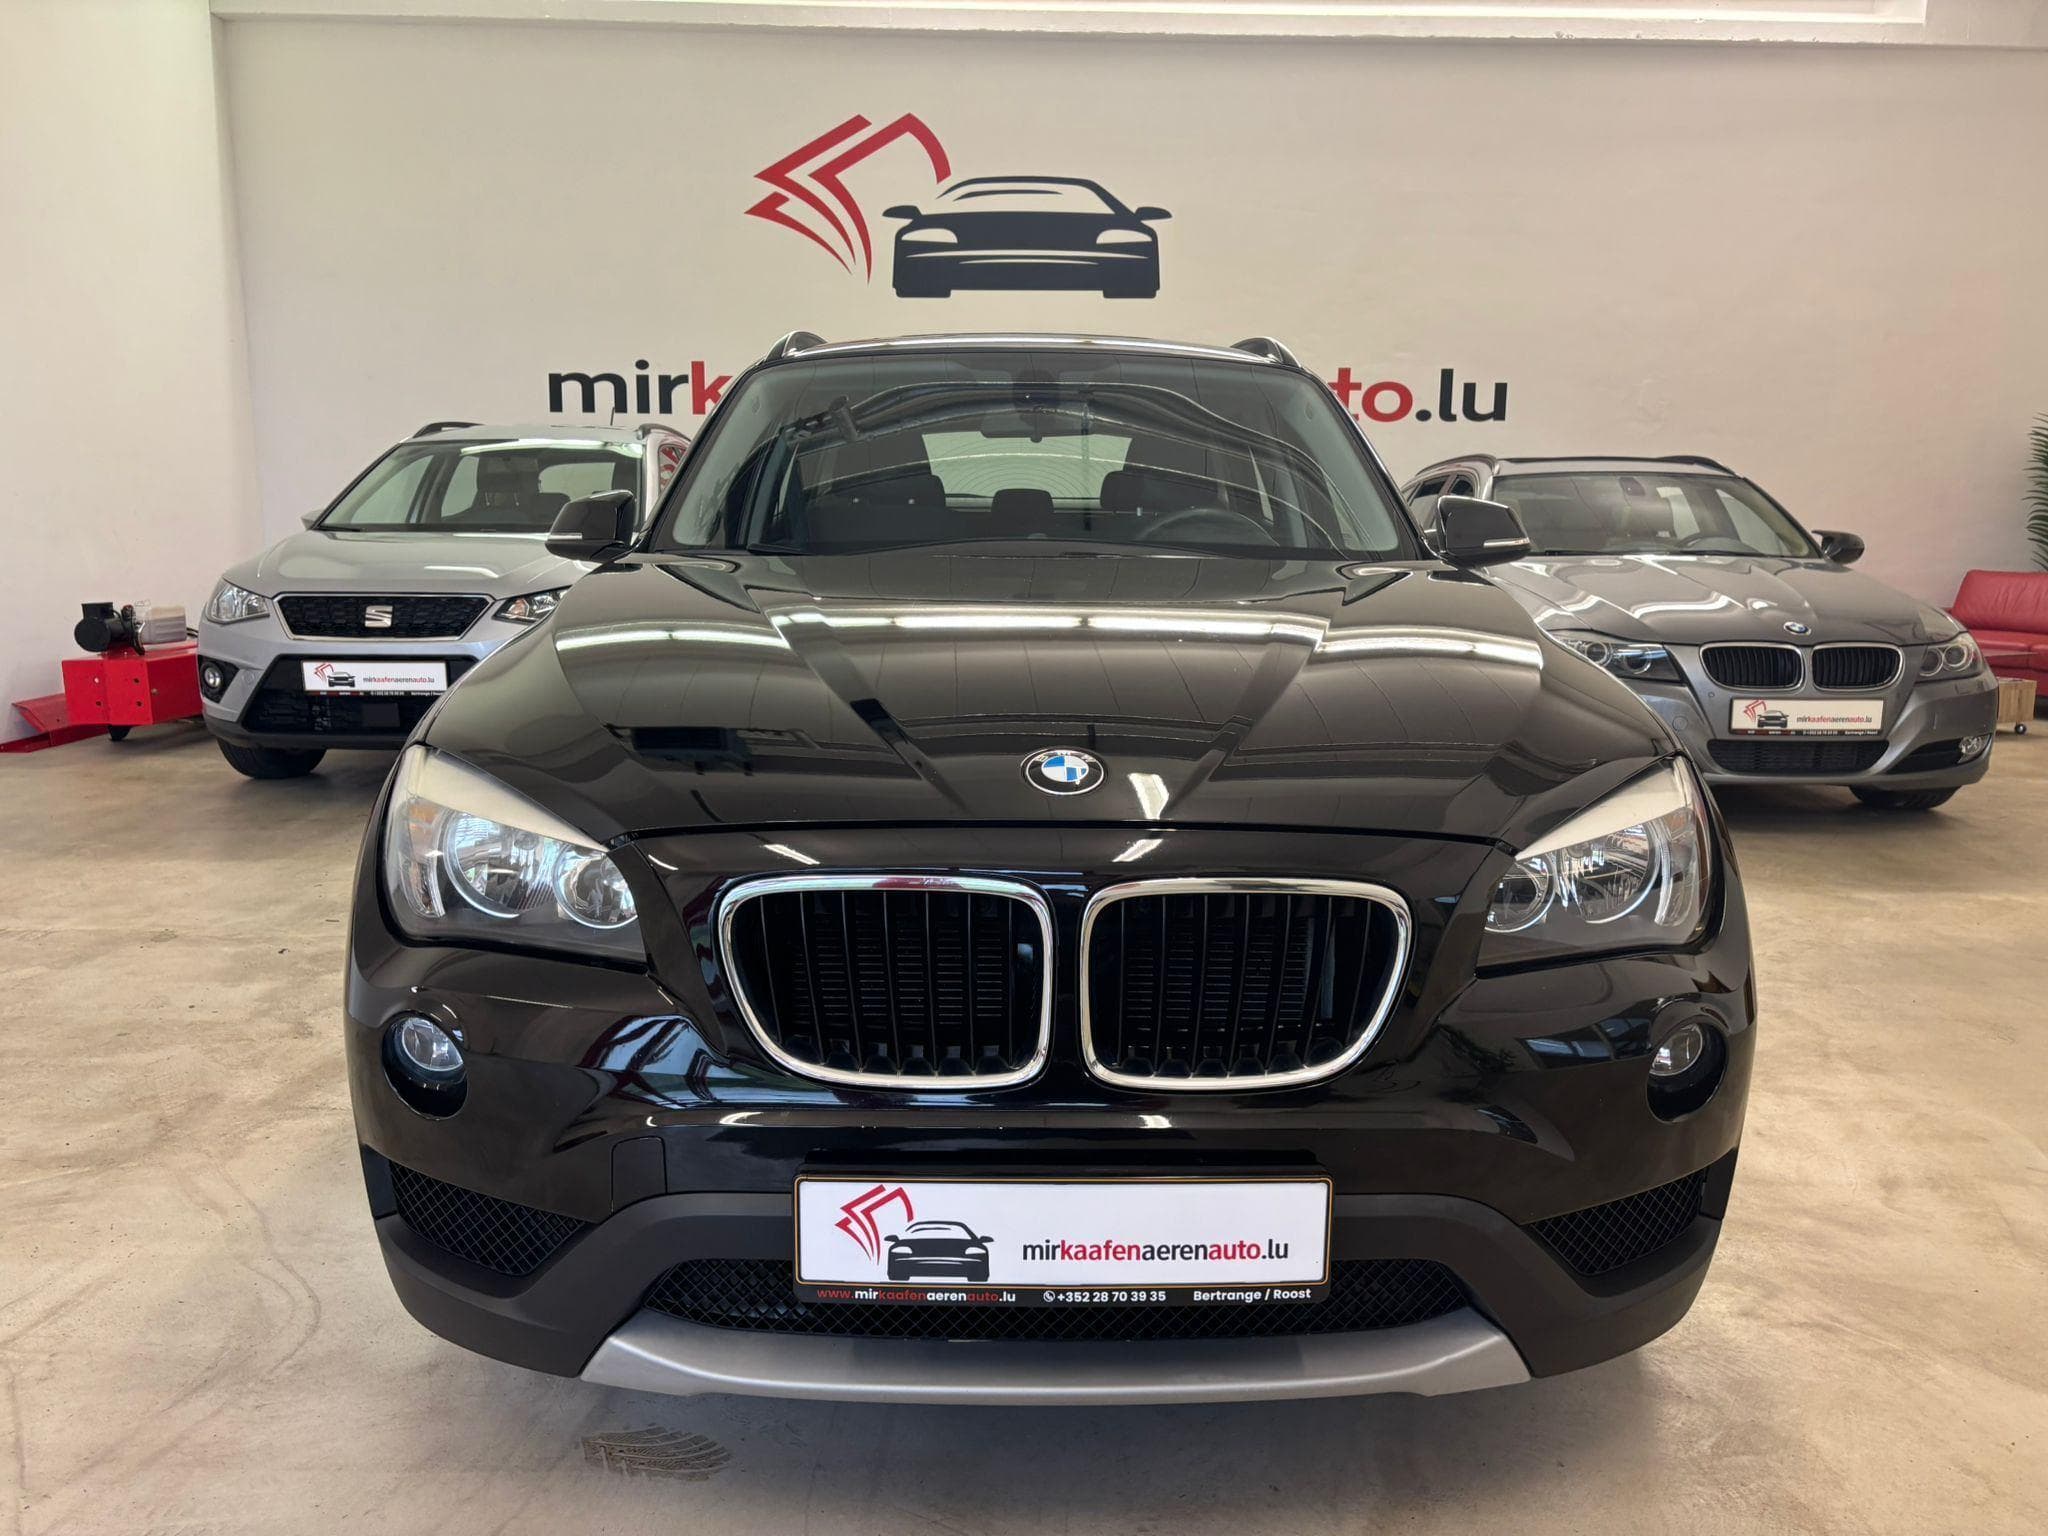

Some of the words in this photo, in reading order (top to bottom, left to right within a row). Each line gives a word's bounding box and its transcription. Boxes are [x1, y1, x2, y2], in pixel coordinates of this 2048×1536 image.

[1022, 1239, 1289, 1261] mirkaafenaerenauto.lu
[816, 1288, 1016, 1303] www.mirkaafenaerenauto.lu
[1057, 1291, 1090, 1302] +352
[1092, 1291, 1109, 1302] 28
[1111, 1291, 1128, 1302] 70
[1130, 1291, 1147, 1302] 39
[1150, 1290, 1167, 1301] 35
[1193, 1289, 1262, 1303] Bertrange
[1273, 1288, 1312, 1300] Roost
